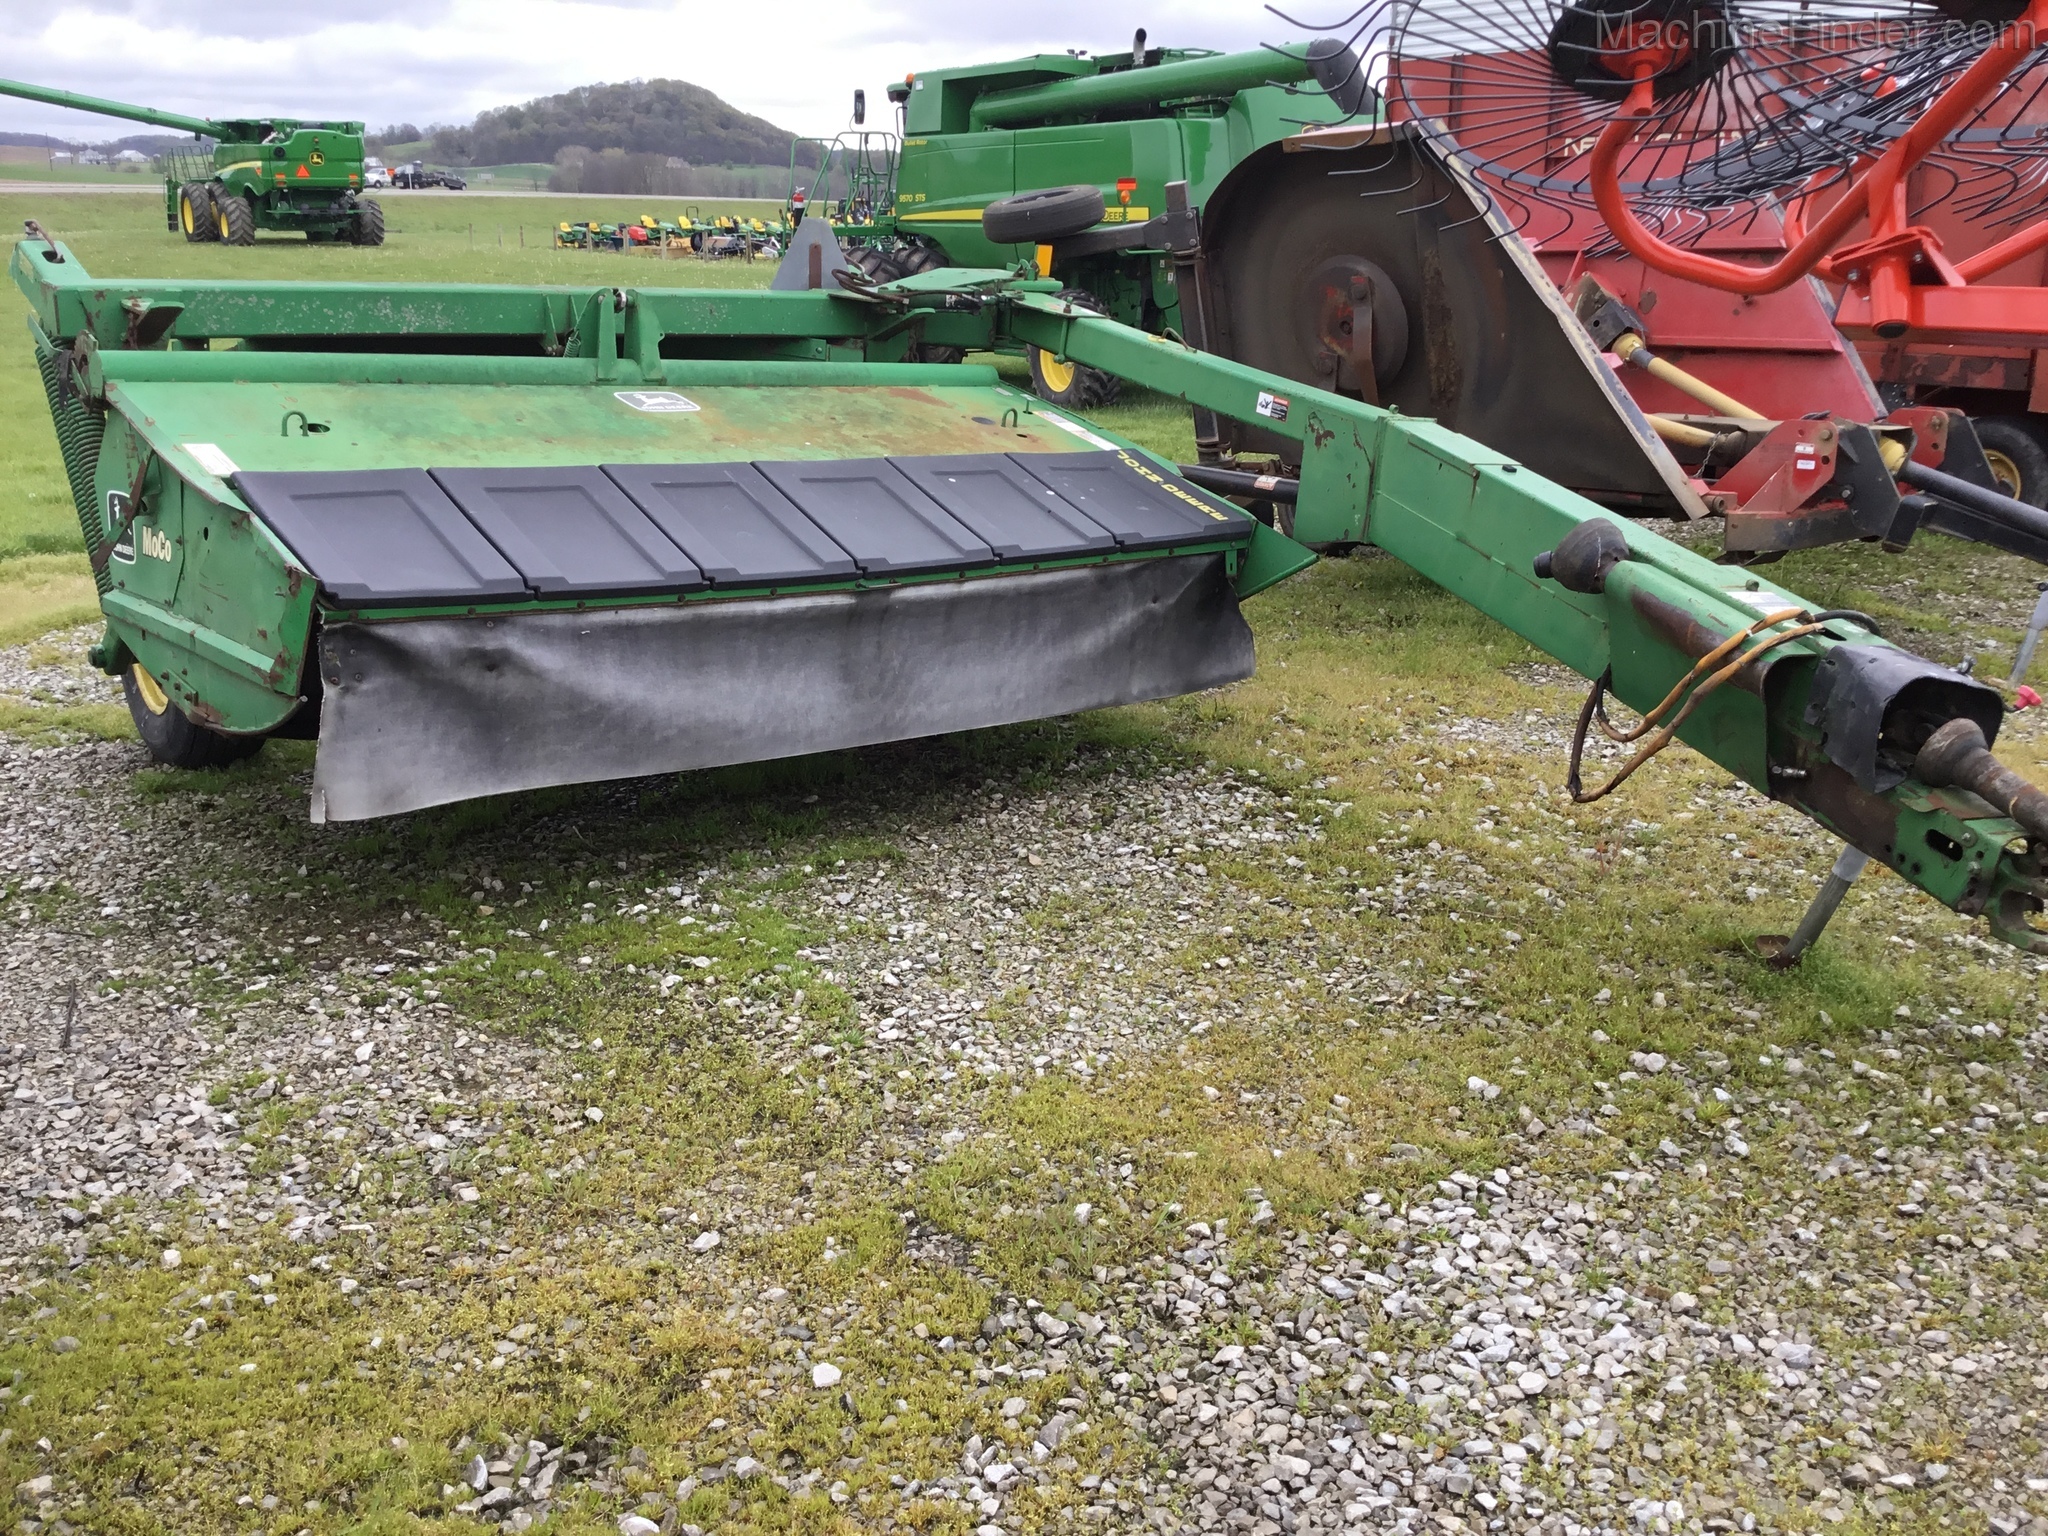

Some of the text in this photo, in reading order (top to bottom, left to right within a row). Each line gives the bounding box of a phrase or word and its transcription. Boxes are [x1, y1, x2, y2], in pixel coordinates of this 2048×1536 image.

[899, 193, 926, 203] 9570 STS
[1161, 483, 1229, 521] DEERE
[142, 526, 172, 563] MoCo
